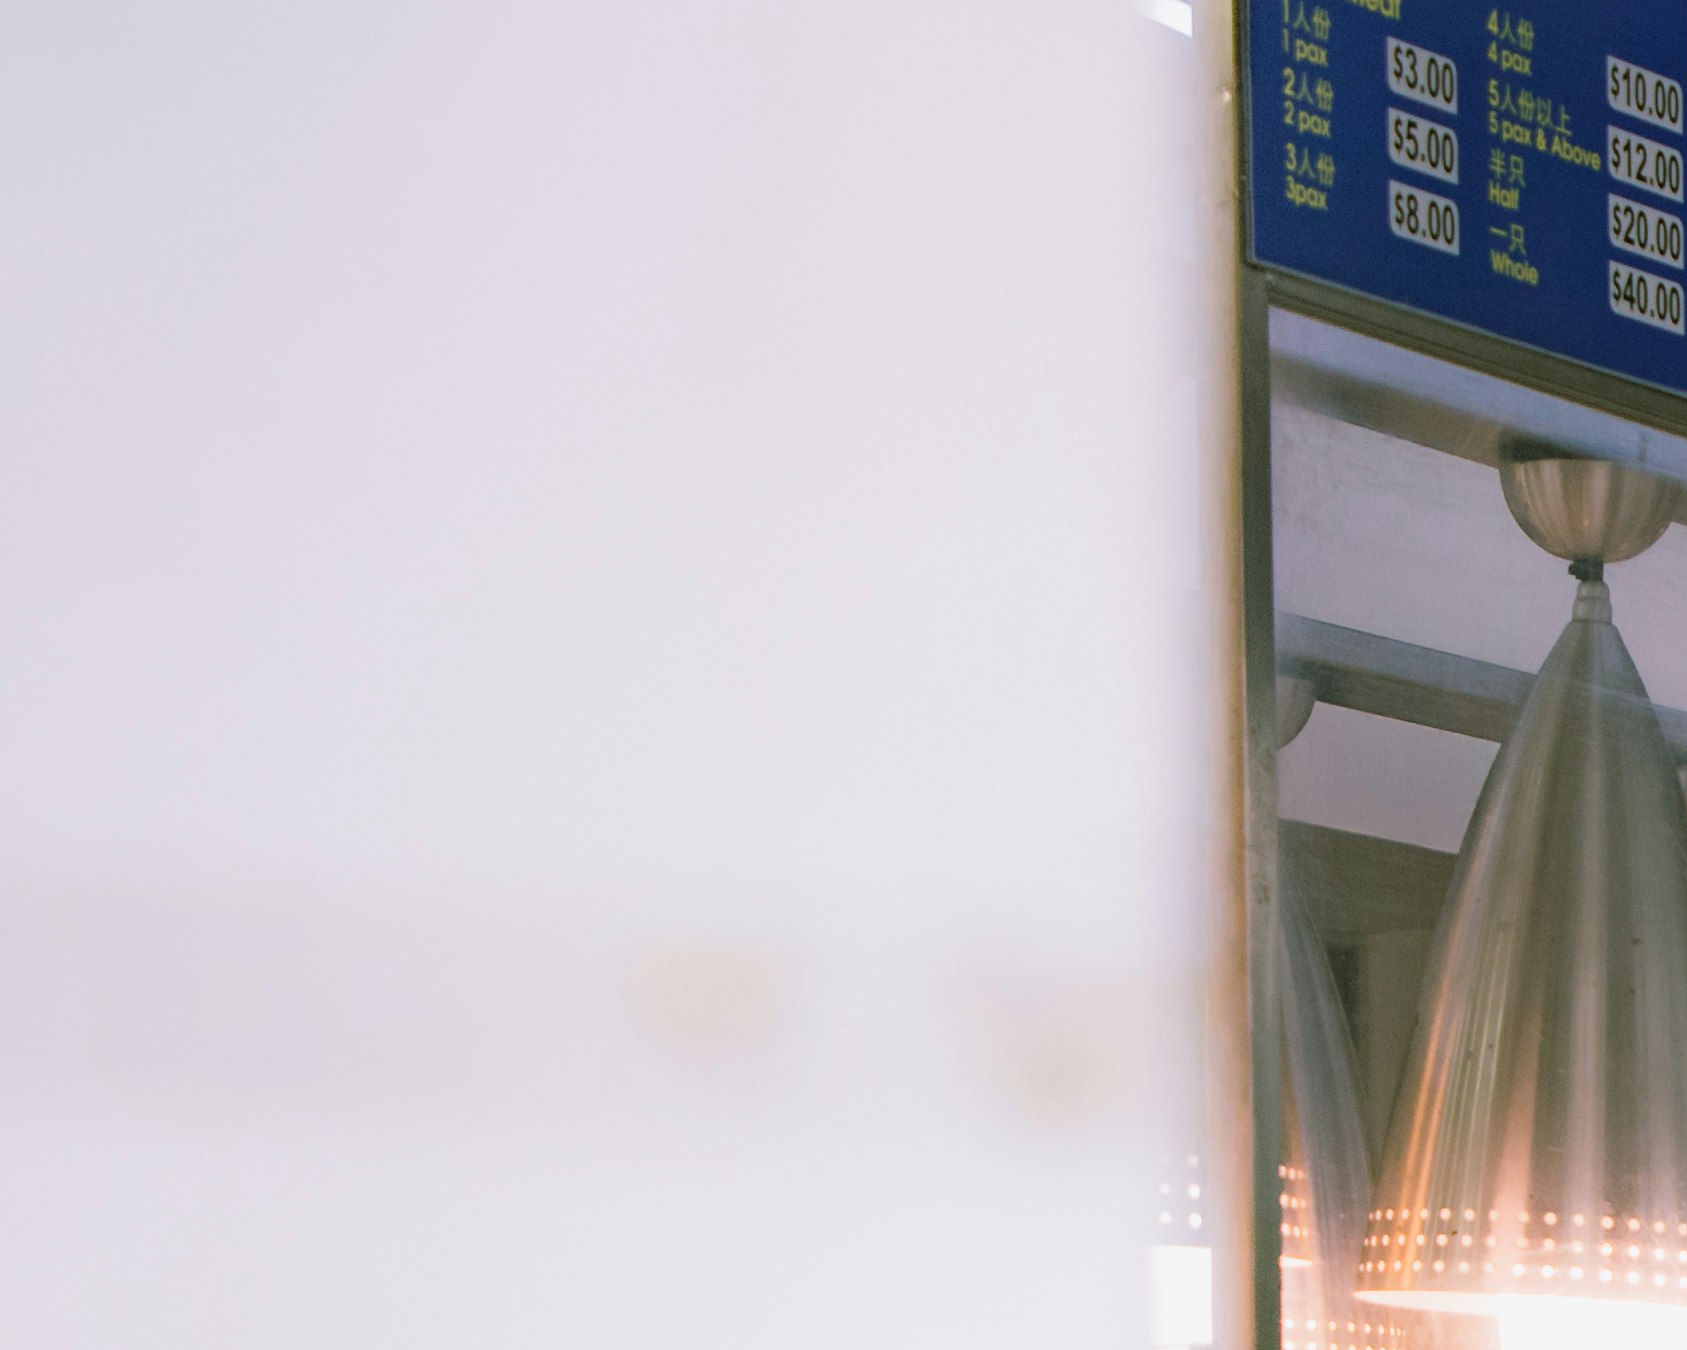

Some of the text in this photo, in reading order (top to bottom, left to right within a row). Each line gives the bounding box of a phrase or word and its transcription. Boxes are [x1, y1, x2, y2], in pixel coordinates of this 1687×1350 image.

[1295, 39, 1327, 65] pax
[1487, 10, 1534, 51] 4人份
[1283, 68, 1333, 114] 2人份
[1394, 46, 1454, 109] $3.00
[1611, 66, 1679, 128] $10.00
[1298, 110, 1330, 137] pax
[1488, 79, 1571, 138] 5人份以上
[1285, 143, 1335, 185] 3人份
[1394, 118, 1454, 179] $5.00
[1488, 150, 1524, 188] 半只
[1501, 120, 1532, 149] pax
[1551, 132, 1600, 170] Above
[1612, 137, 1679, 197] $12.00
[1488, 182, 1519, 209] Half
[1395, 192, 1455, 250] $8.00
[1490, 224, 1525, 254] 一只
[1613, 204, 1680, 264] $20.00
[1491, 250, 1538, 285] Whole
[1613, 270, 1680, 329] $40.00
